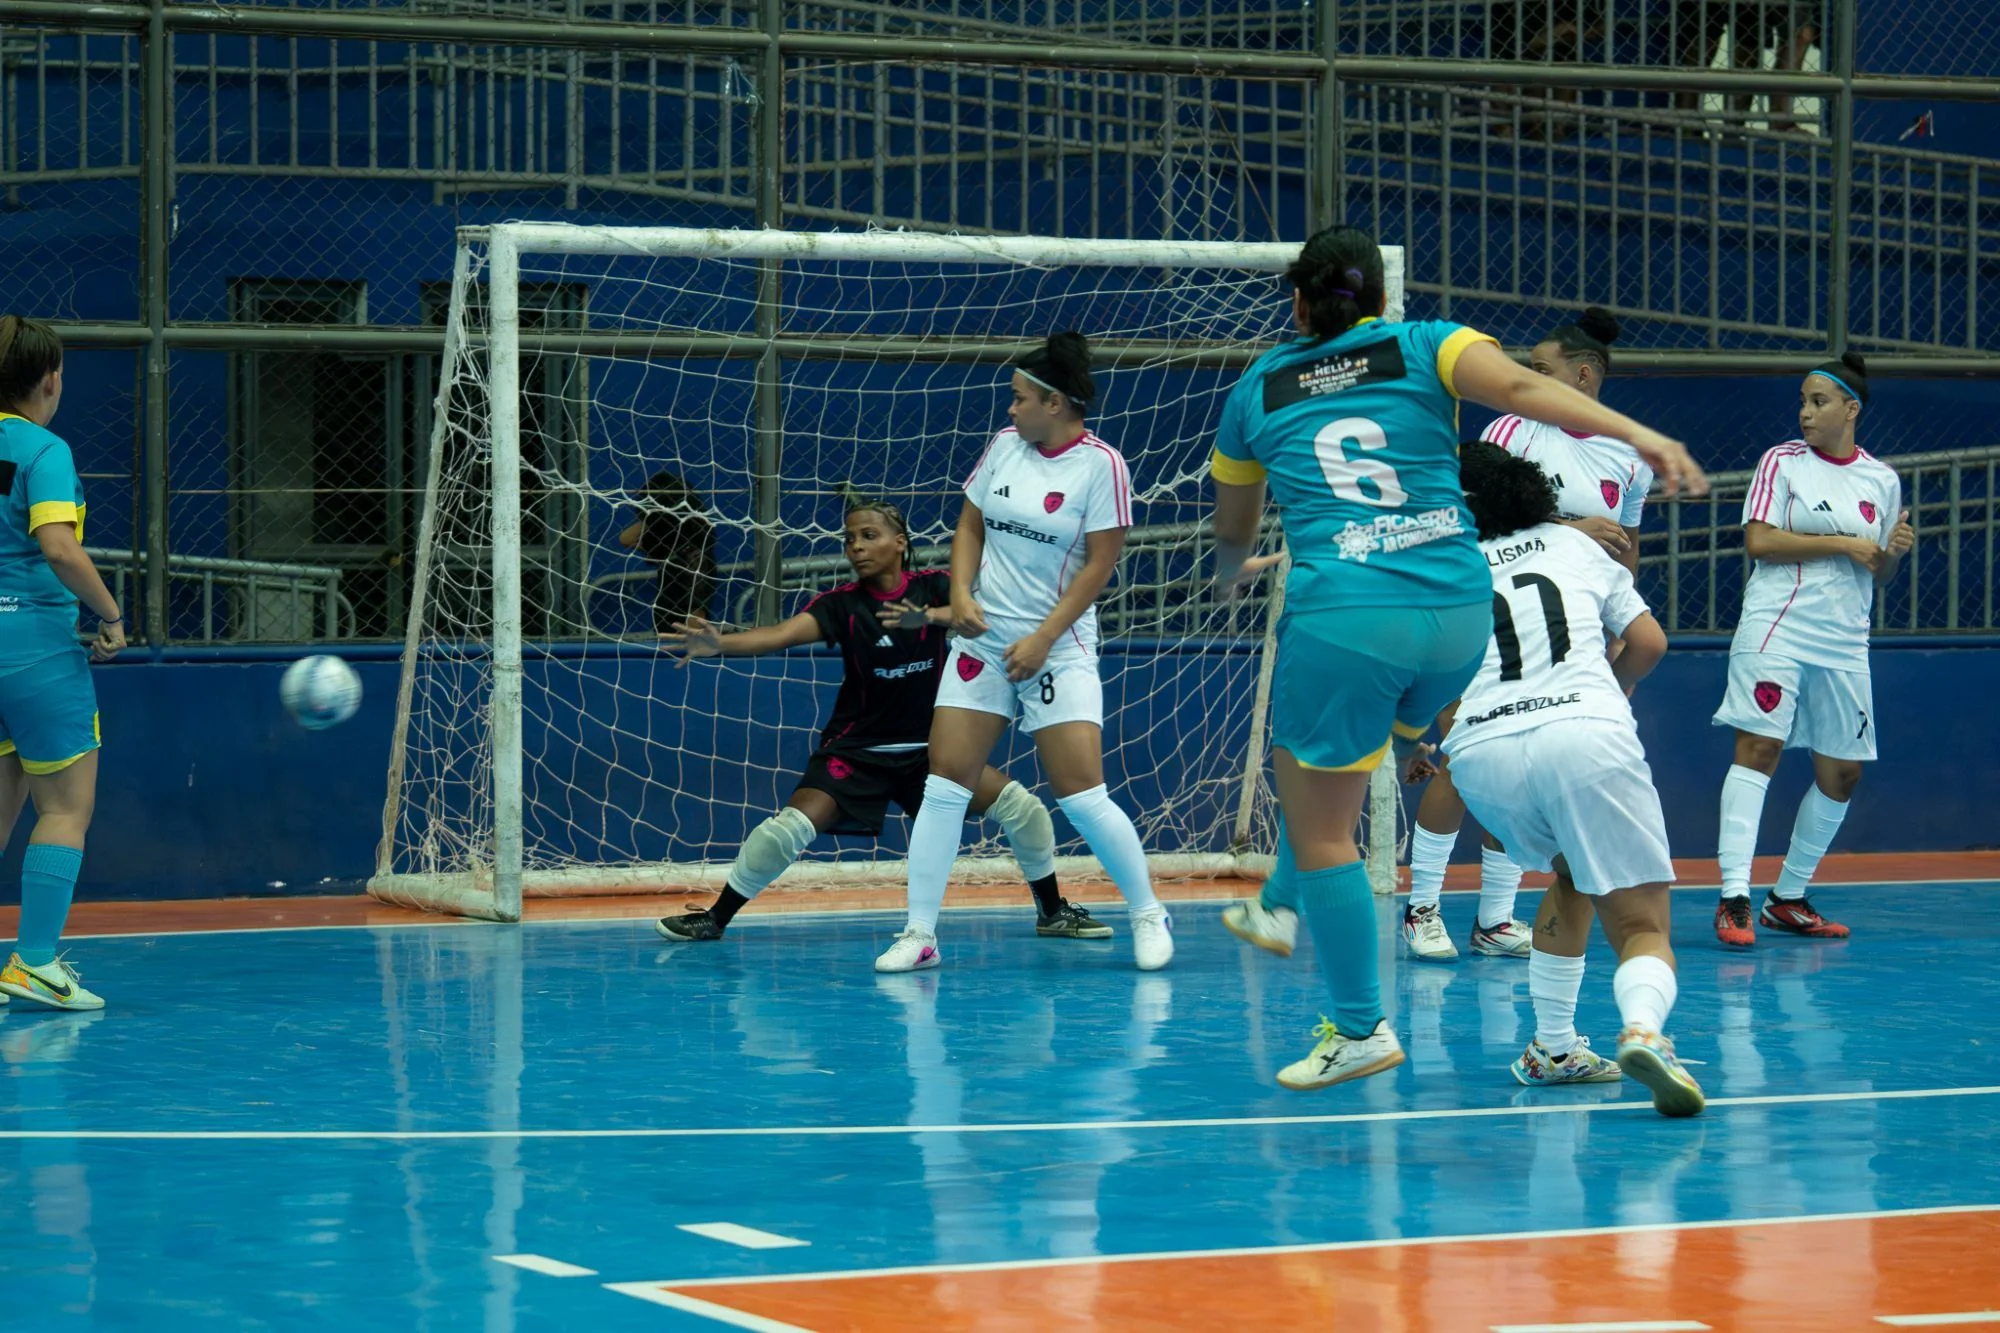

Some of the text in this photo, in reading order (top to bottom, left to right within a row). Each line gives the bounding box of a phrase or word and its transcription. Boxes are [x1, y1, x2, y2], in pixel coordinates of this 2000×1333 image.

[1315, 360, 1352, 377] HELLP
[1314, 417, 1408, 507] 6
[1039, 672, 1055, 704] 8
